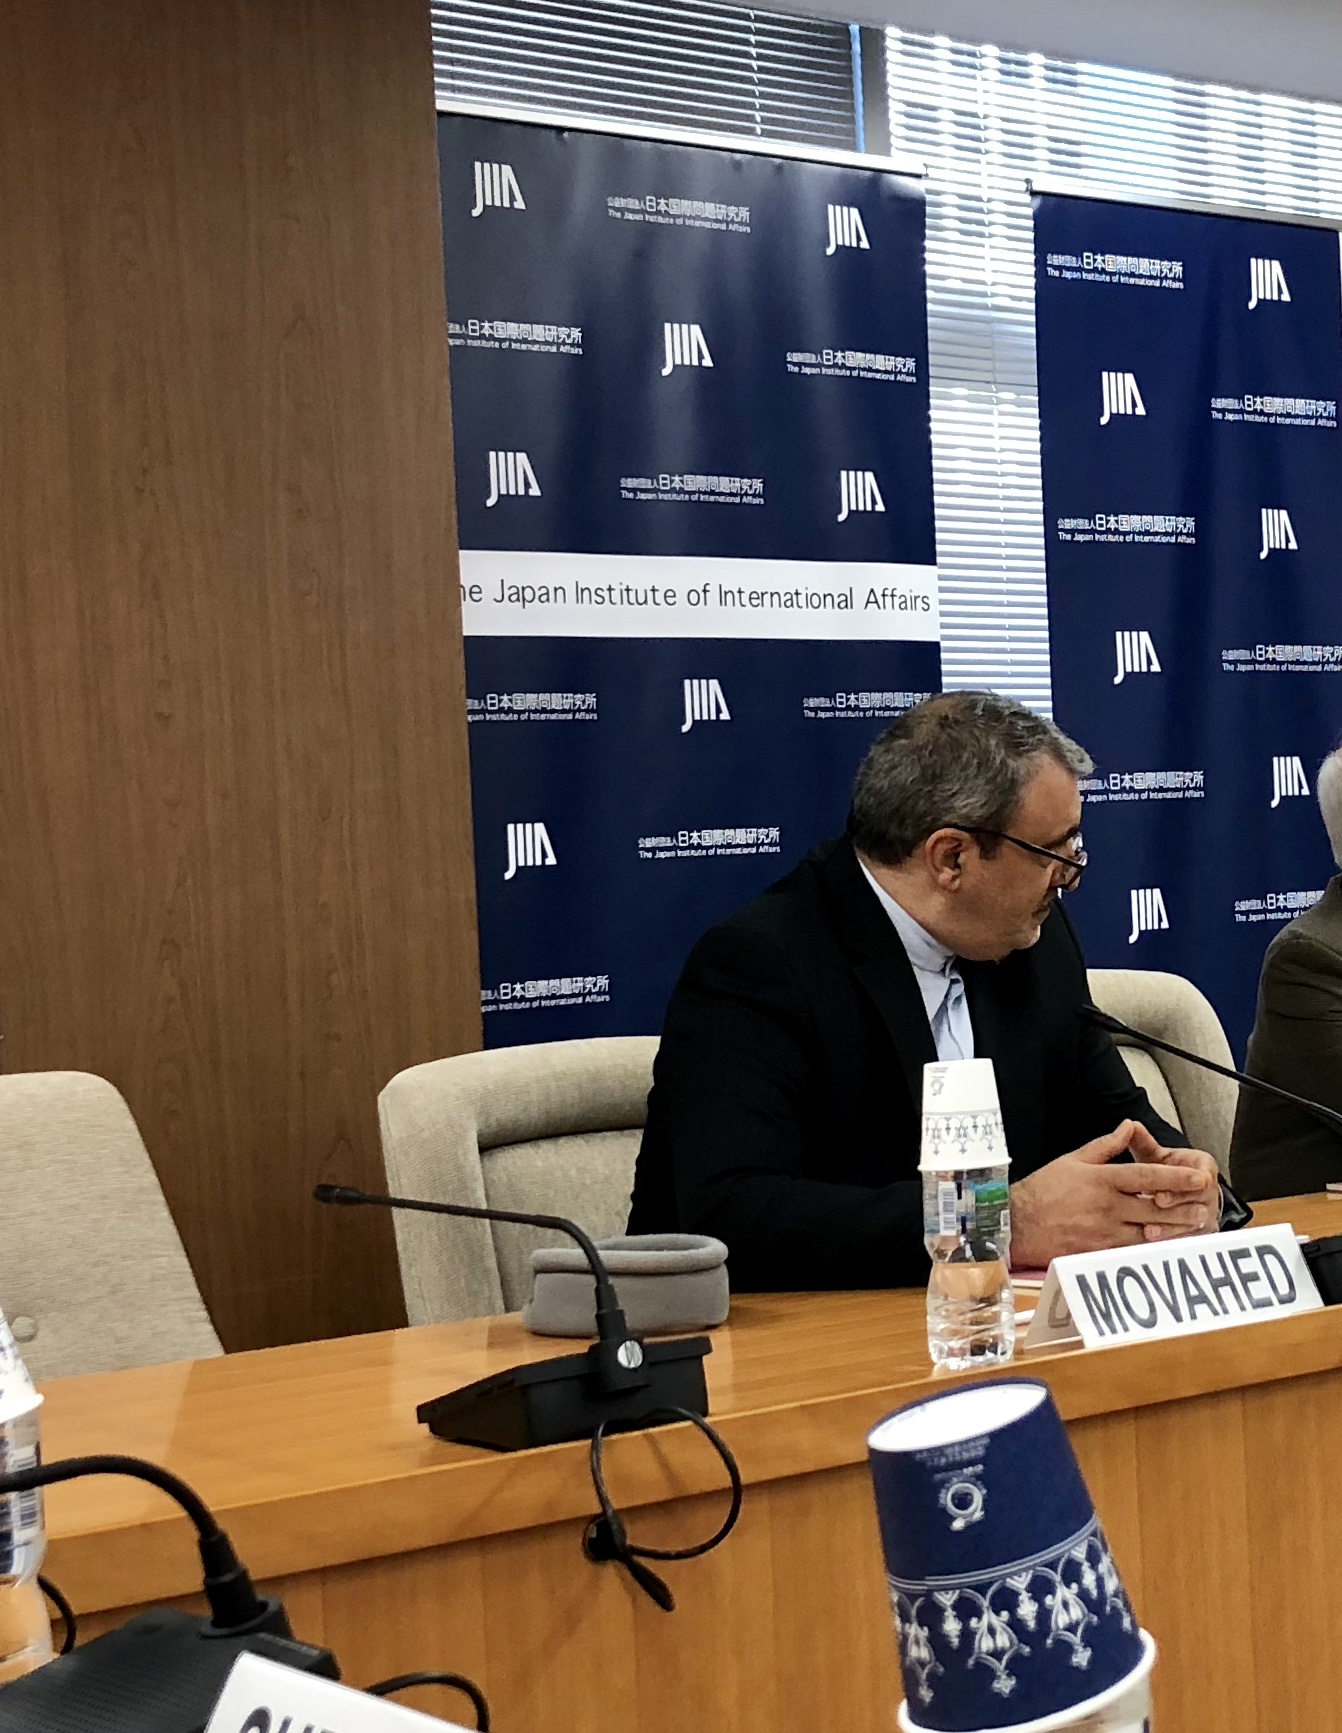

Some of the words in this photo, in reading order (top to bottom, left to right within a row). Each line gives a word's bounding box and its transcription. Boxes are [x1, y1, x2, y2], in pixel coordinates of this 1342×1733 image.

[471, 161, 526, 217] JIIA
[608, 208, 621, 218] The
[676, 217, 683, 225] of
[826, 204, 871, 256] JIIA
[1046, 267, 1059, 277] The
[1112, 274, 1118, 283] of
[1248, 257, 1291, 310] JIIA
[661, 322, 714, 377] JIIA
[787, 364, 799, 372] The
[1100, 371, 1146, 426] JIIA
[1211, 411, 1222, 419] The
[485, 450, 542, 508] JIIA
[621, 490, 634, 498] The
[837, 470, 886, 522] JIIA
[1058, 532, 1071, 540] The
[1126, 534, 1132, 542] of
[1259, 508, 1299, 560] JIIA
[493, 578, 567, 609] Japan
[575, 580, 677, 607] Institute
[687, 583, 711, 607] of
[719, 584, 854, 611] International
[864, 588, 931, 612] Affairs
[1113, 630, 1162, 685] JIIA
[1222, 663, 1234, 671] The
[1281, 663, 1287, 671] of
[468, 714, 484, 722] pan
[520, 712, 528, 720] of
[681, 678, 731, 733] JIIA
[1141, 791, 1148, 799] of
[1271, 756, 1310, 809] JIIA
[504, 822, 557, 881] JIIA
[1128, 888, 1170, 944] JIIA
[1235, 914, 1246, 922] The
[1293, 910, 1299, 918] of
[482, 1004, 497, 1012] pan
[532, 1000, 539, 1008] of
[1075, 1243, 1298, 1337] MOVAHED
